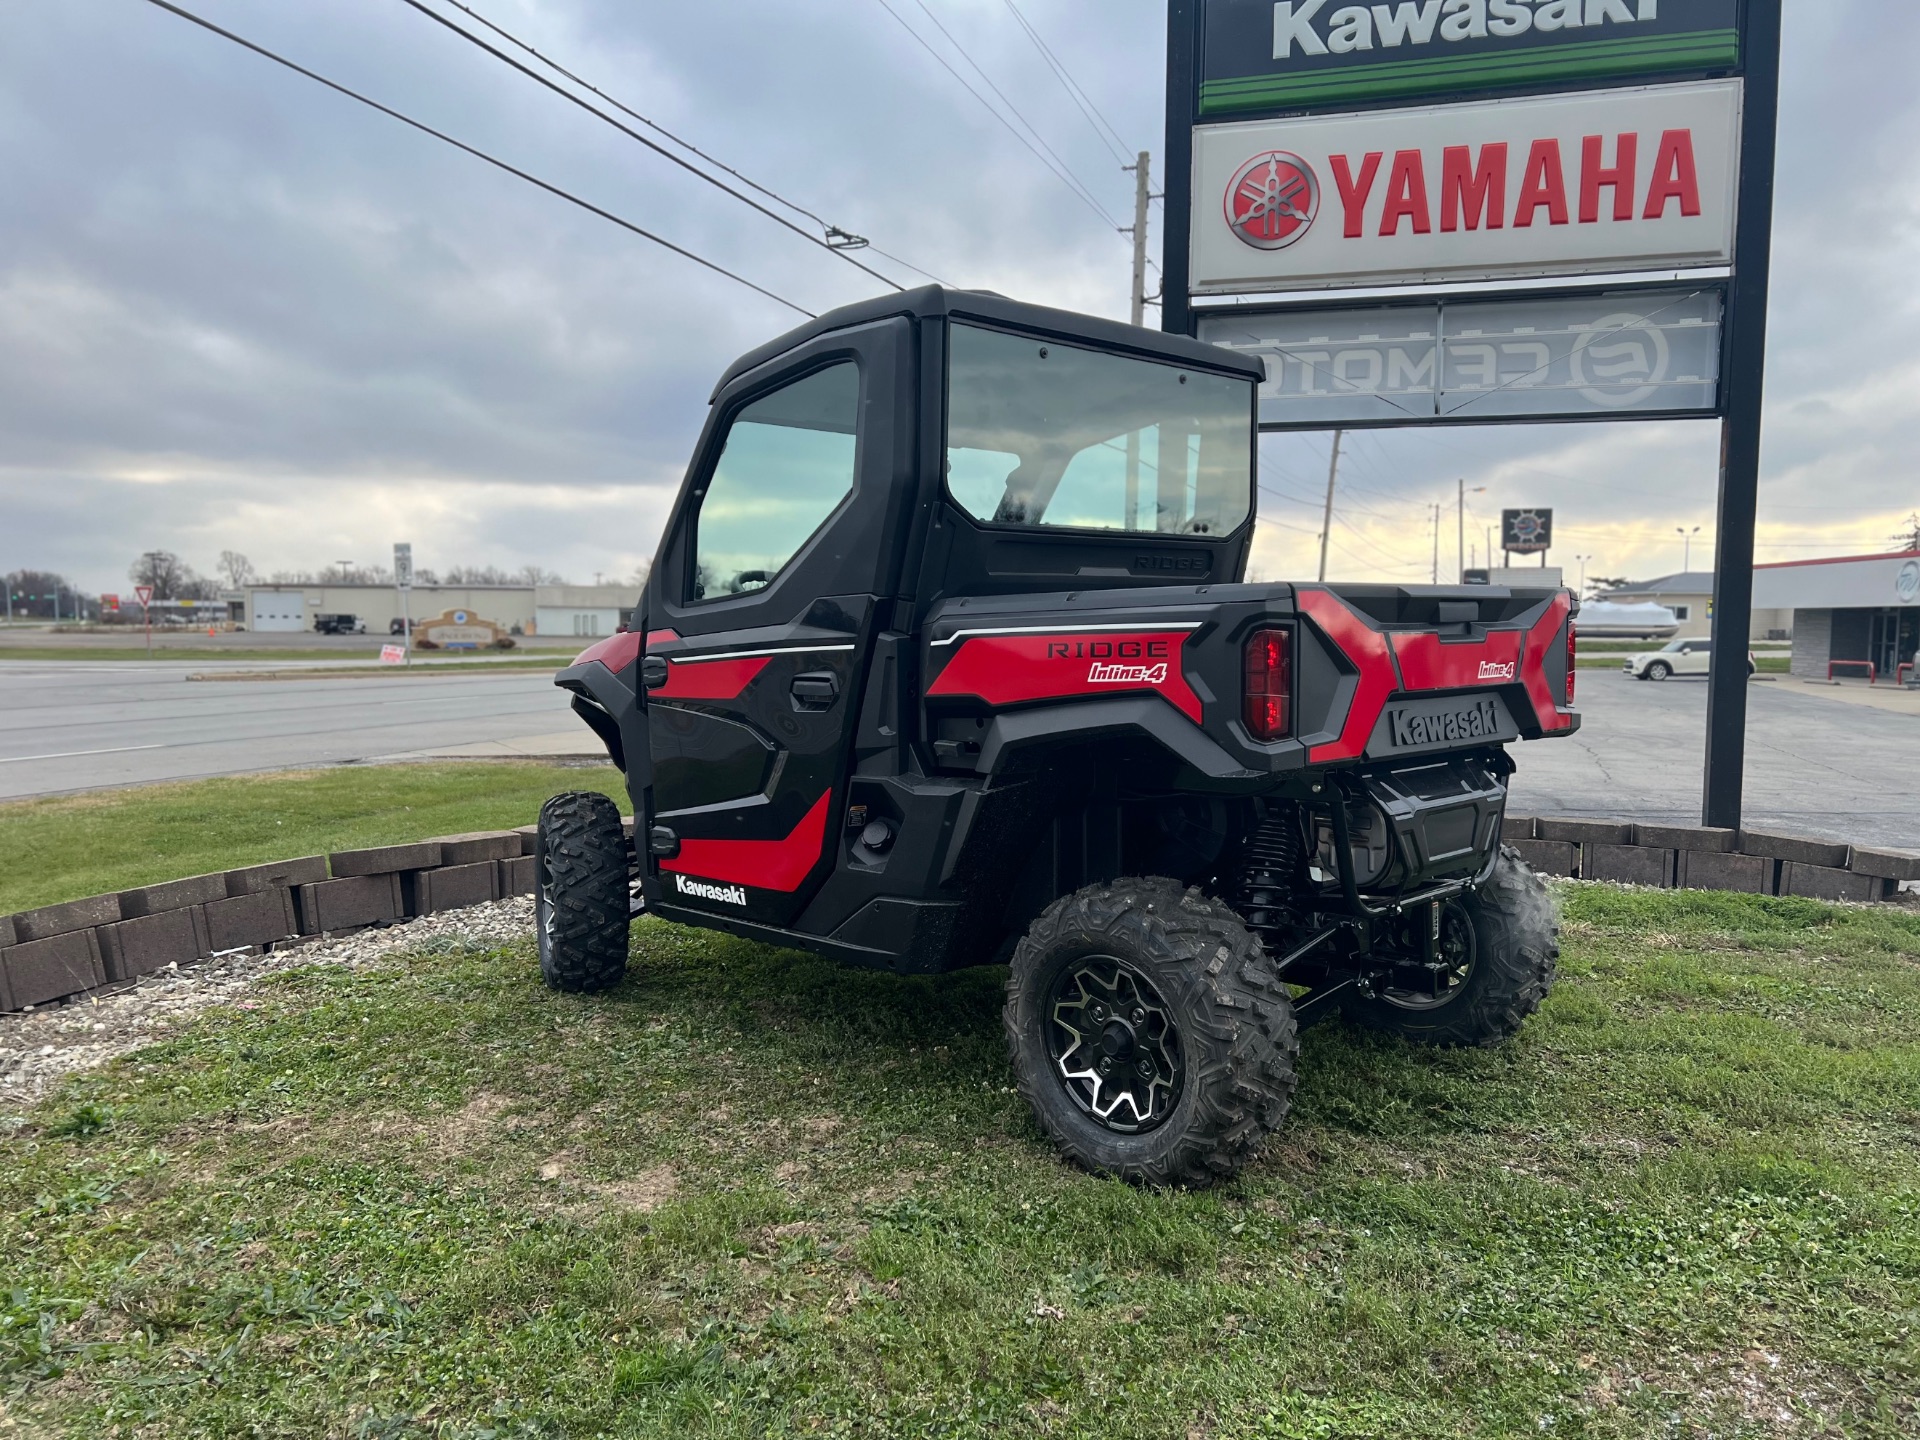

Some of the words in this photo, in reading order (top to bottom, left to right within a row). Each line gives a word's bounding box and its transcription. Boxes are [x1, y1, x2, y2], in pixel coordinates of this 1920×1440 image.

[1328, 129, 1701, 238] YAMAHA
[1134, 554, 1204, 570] RIDGE
[1047, 641, 1168, 658] RIDGE
[1087, 661, 1168, 683] Inline-4
[1477, 660, 1515, 679] Inline-4
[1389, 700, 1500, 747] Kawasaki
[675, 874, 747, 906] Kawasaki
